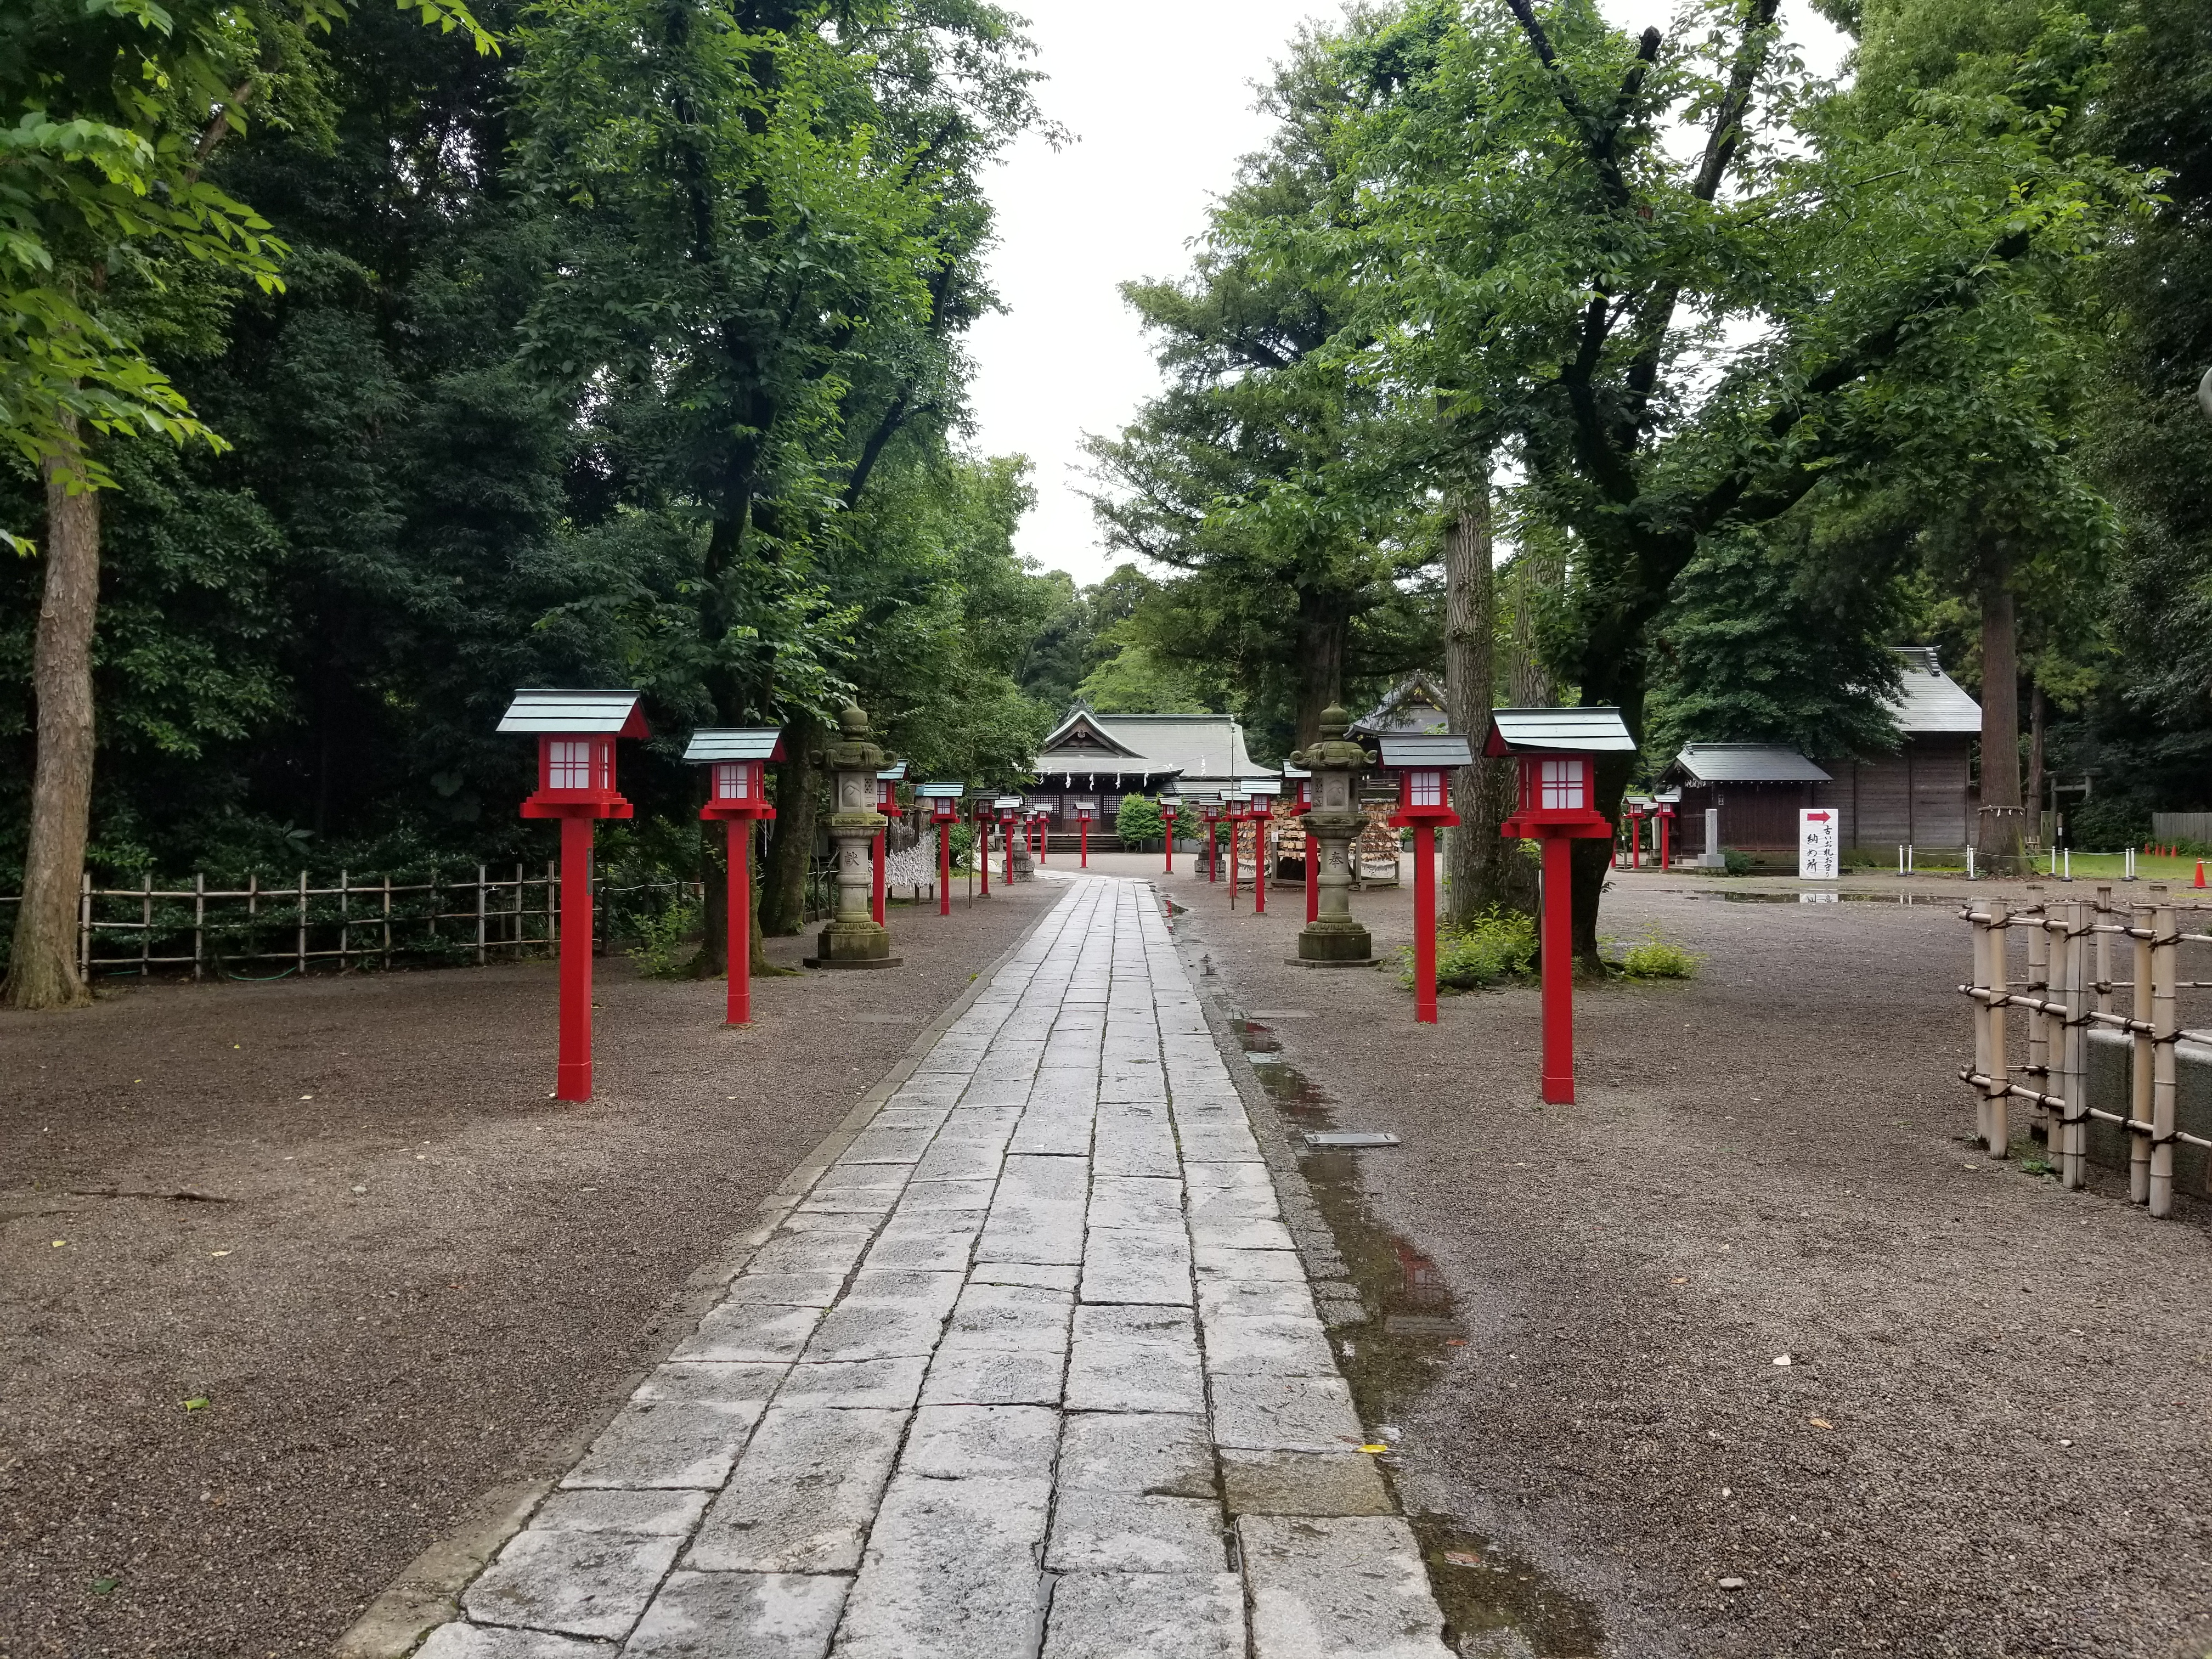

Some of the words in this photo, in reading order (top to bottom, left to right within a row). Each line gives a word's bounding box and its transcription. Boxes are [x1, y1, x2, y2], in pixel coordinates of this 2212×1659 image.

[1329, 851, 1344, 868] 奉
[1807, 833, 1818, 873] 納め所
[1823, 825, 1833, 878] 古いお札お守り
